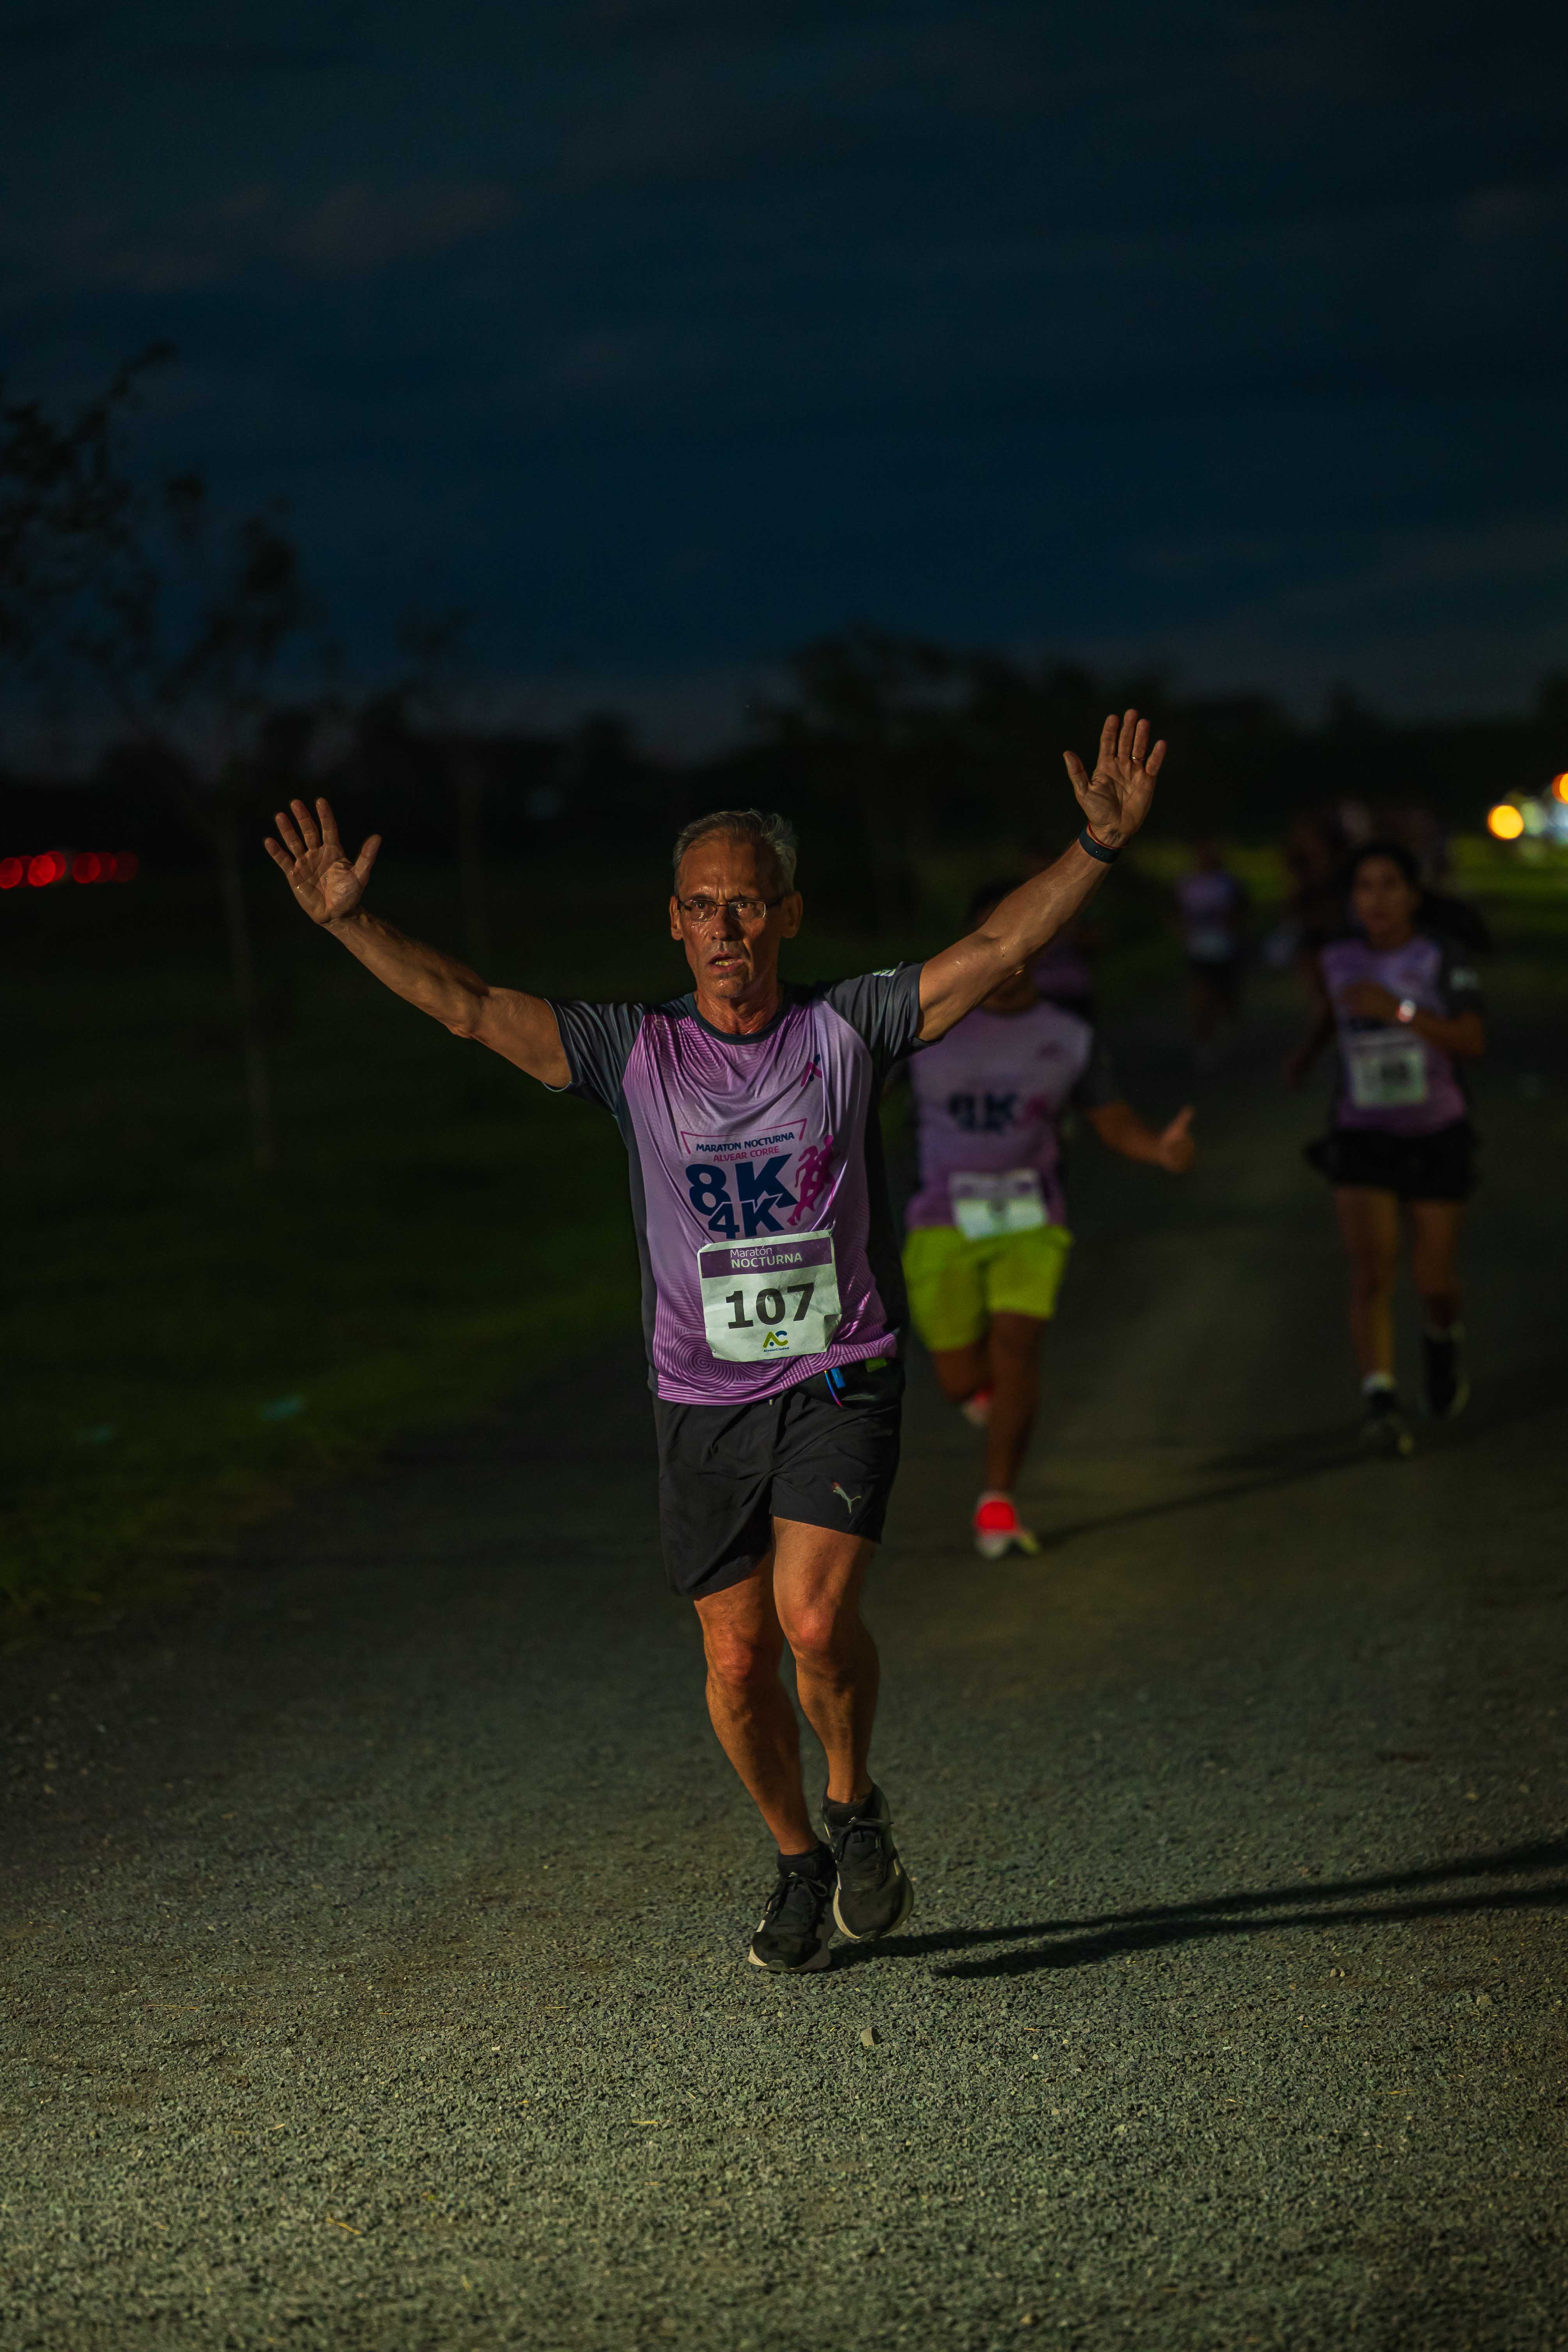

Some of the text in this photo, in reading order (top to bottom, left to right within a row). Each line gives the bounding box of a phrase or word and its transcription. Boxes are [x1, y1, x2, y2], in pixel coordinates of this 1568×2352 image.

[696, 1132, 795, 1152] MARATON NOCTURNA
[713, 1146, 779, 1162] ALVEAR CORRE
[685, 1153, 797, 1216] 8K
[708, 1196, 784, 1239] 4K
[730, 1246, 772, 1257] Maratón
[731, 1252, 803, 1268] NOCTURNA
[726, 1282, 814, 1329] 107
